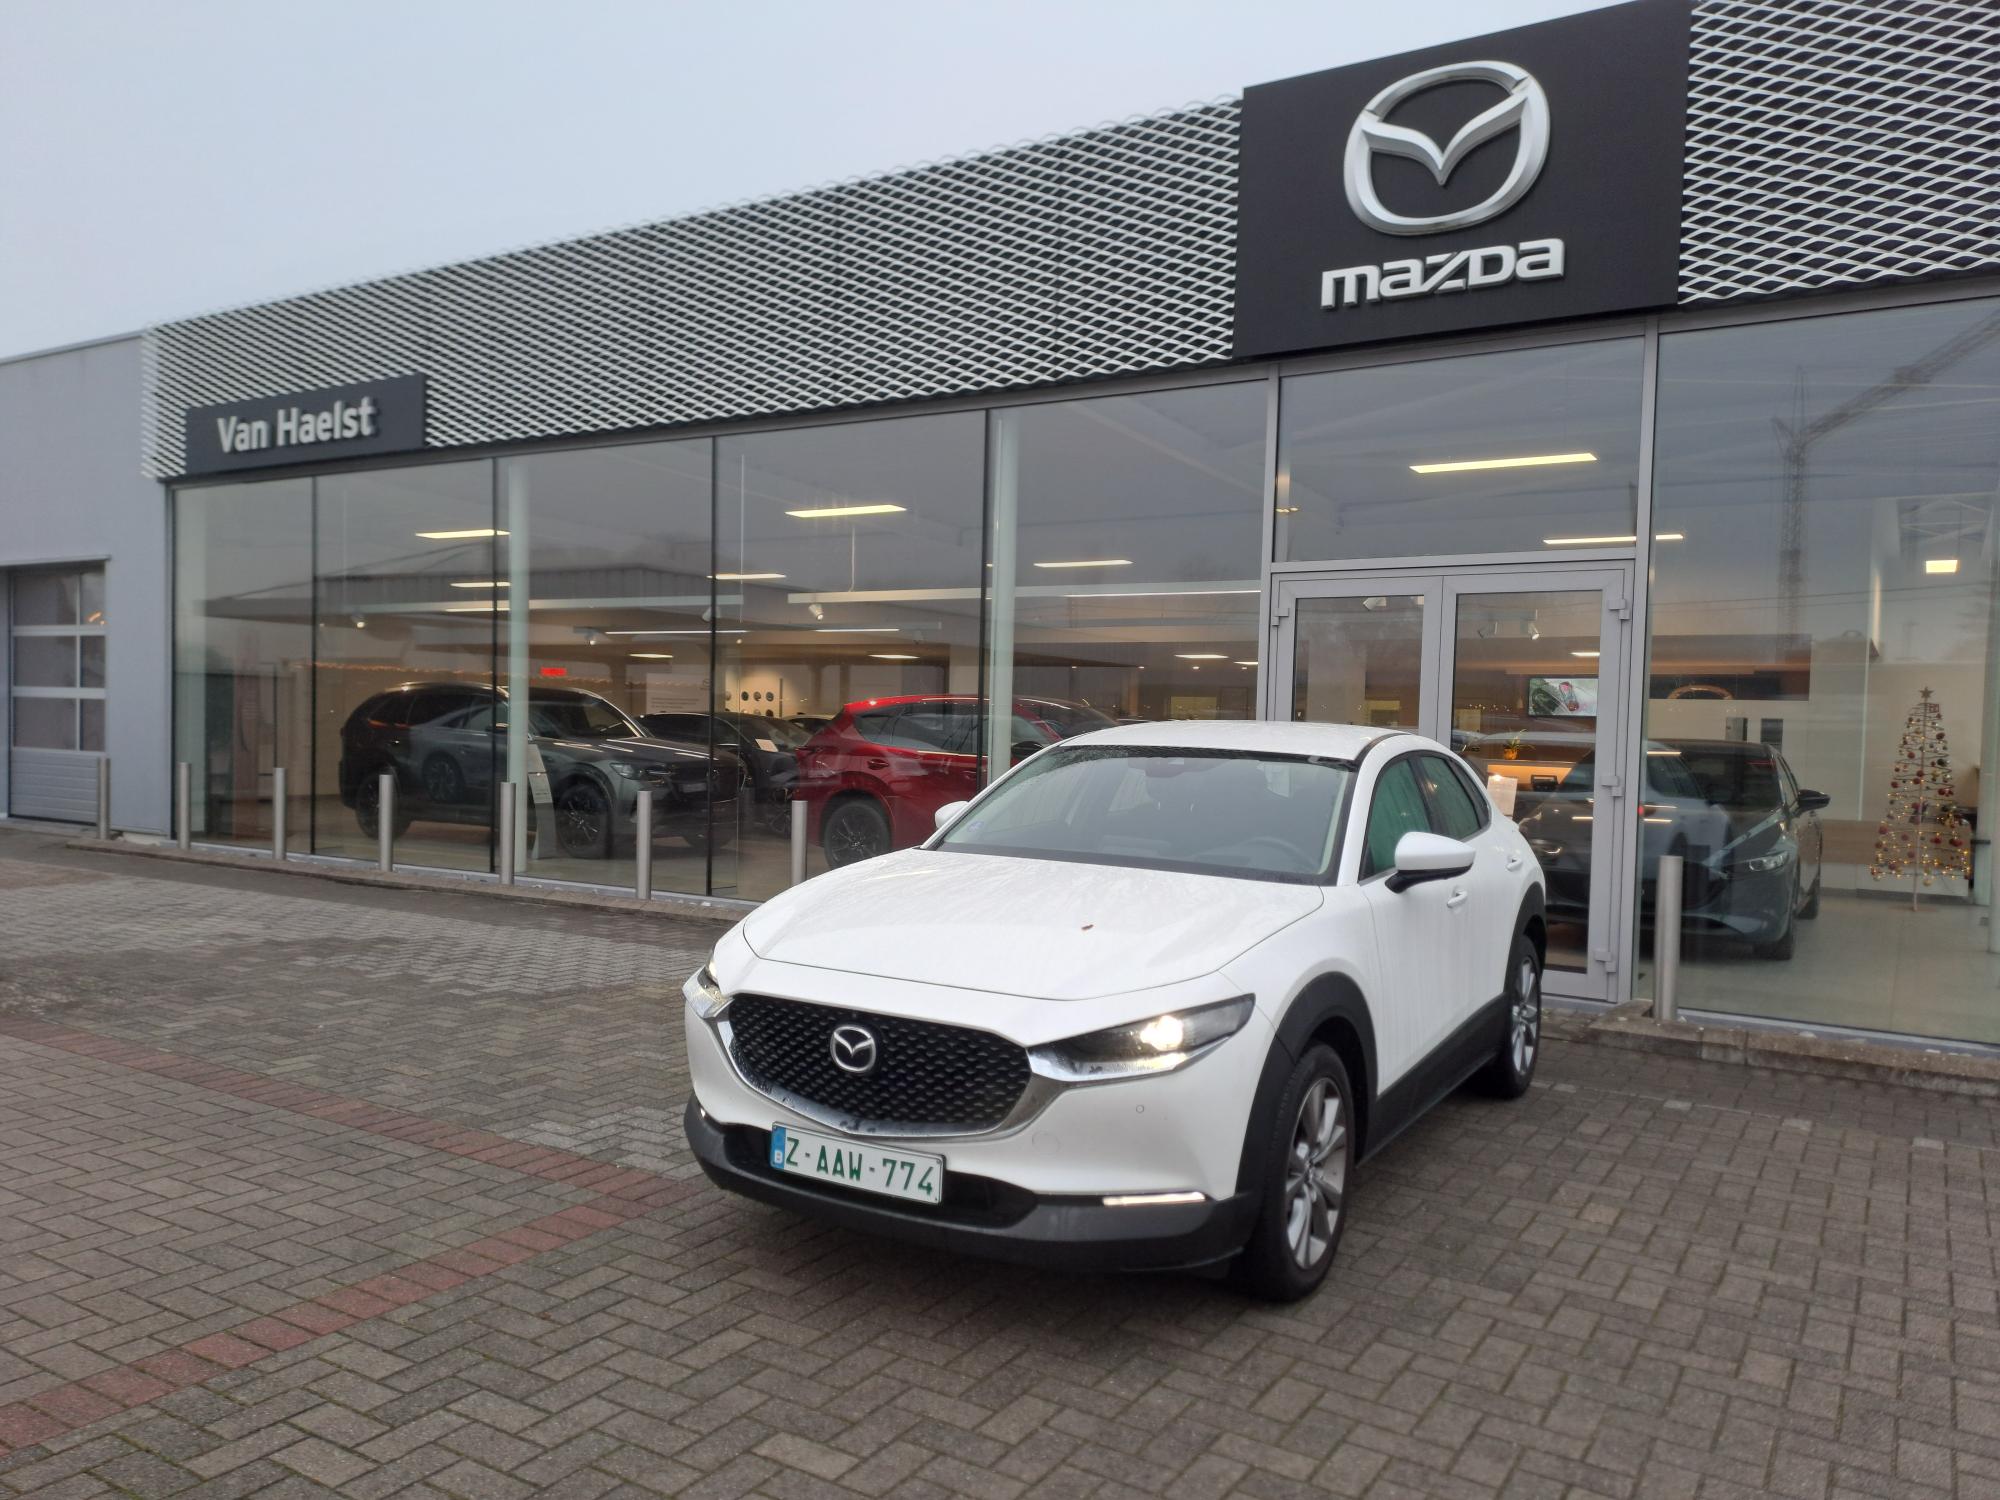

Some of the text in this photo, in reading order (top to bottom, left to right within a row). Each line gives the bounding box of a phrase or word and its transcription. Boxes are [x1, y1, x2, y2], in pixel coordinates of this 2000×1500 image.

[217, 396, 376, 453] Van Haelst
[785, 1137, 934, 1195] Z-AAW-774
